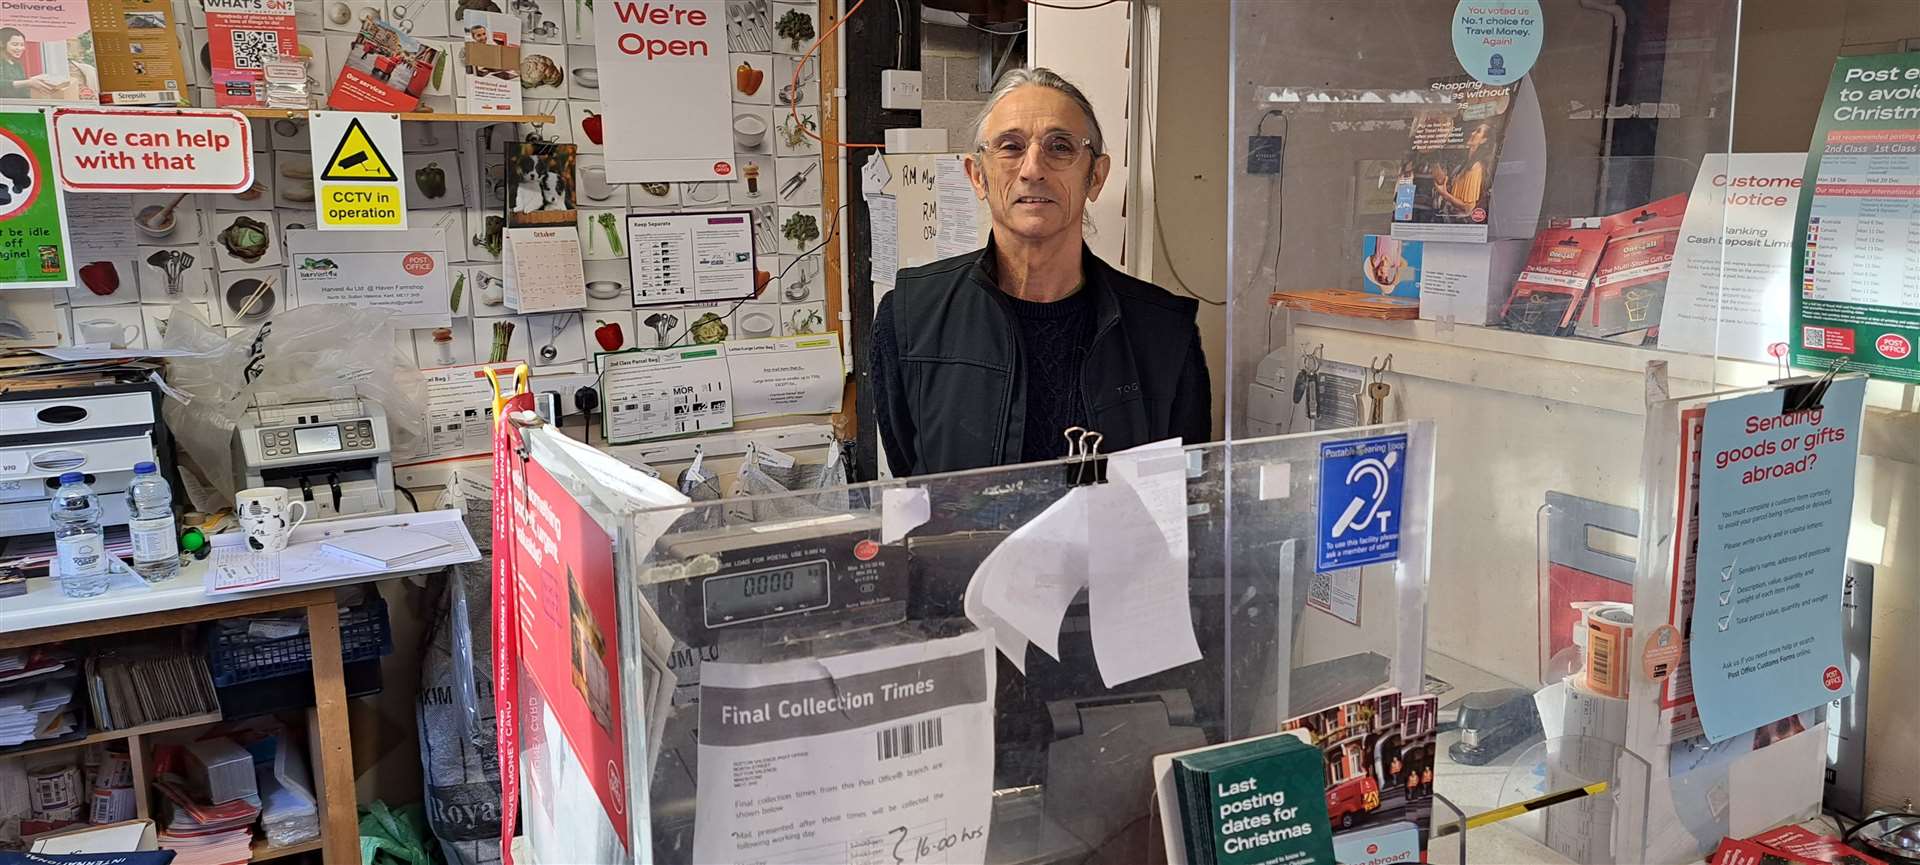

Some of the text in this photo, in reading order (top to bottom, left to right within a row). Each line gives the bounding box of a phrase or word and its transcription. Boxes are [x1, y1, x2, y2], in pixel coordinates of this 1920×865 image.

[1, 2, 64, 11] Delivered.
[1469, 7, 1486, 15] You
[1488, 7, 1516, 15] voted
[614, 2, 706, 25] We're
[1462, 17, 1535, 25] No.1 choice for
[1465, 27, 1530, 37] Travel Money.
[618, 33, 708, 60] Open
[1483, 39, 1512, 47] Again!
[1845, 67, 1900, 82] Post
[359, 81, 387, 96] services
[1432, 79, 1483, 92] Shopping
[1467, 87, 1511, 98] without
[1840, 89, 1863, 101] to
[72, 127, 230, 152] We can help
[1892, 144, 1916, 152] Class
[75, 151, 195, 170] with that
[902, 164, 917, 187] RM
[1712, 173, 1804, 189] Custome
[333, 191, 389, 203] CCTV in
[1845, 188, 1872, 196] popular
[329, 208, 395, 220] operation
[9, 227, 51, 237] be idle
[5, 238, 23, 247] off
[1687, 235, 1717, 245] Cash
[408, 256, 427, 264] POST
[405, 263, 432, 271] OFFICE
[1880, 345, 1905, 353] OFFICE
[1884, 338, 1902, 347] POST
[673, 386, 694, 395] MOR
[1745, 410, 1823, 434] Sending
[1716, 427, 1845, 469] goods or gifts
[1742, 453, 1817, 485] abroad?
[1377, 510, 1391, 533] T
[1359, 536, 1379, 545] facility
[1342, 546, 1367, 555] member
[1376, 541, 1390, 550] staff
[752, 556, 764, 564] FOR
[1728, 653, 1796, 679] Post Office Customs Forms
[1826, 669, 1838, 679] POST
[1825, 677, 1841, 687] OFFICE
[721, 677, 935, 726] Final Collection Times
[507, 738, 515, 784] MONEY
[735, 799, 753, 808] Final
[757, 793, 792, 805] collection
[796, 789, 816, 798] times
[820, 785, 838, 793] from
[842, 782, 855, 790] this
[858, 778, 874, 787] Post
[906, 765, 929, 777] branch
[932, 762, 943, 770] are
[1218, 777, 1257, 798] Last
[507, 785, 516, 834] TRAVEL
[1220, 790, 1285, 820] posting
[430, 796, 497, 829] Roya
[736, 806, 783, 819] shown below
[757, 823, 794, 837] presented
[799, 820, 816, 829] after
[822, 815, 841, 824] these
[846, 811, 866, 819] times
[872, 807, 883, 815] will
[888, 804, 896, 812] be
[901, 796, 929, 809] collected
[934, 792, 944, 800] the
[1222, 806, 1299, 835] dates for
[737, 831, 815, 850] following working day
[1224, 822, 1312, 855] Christmas
